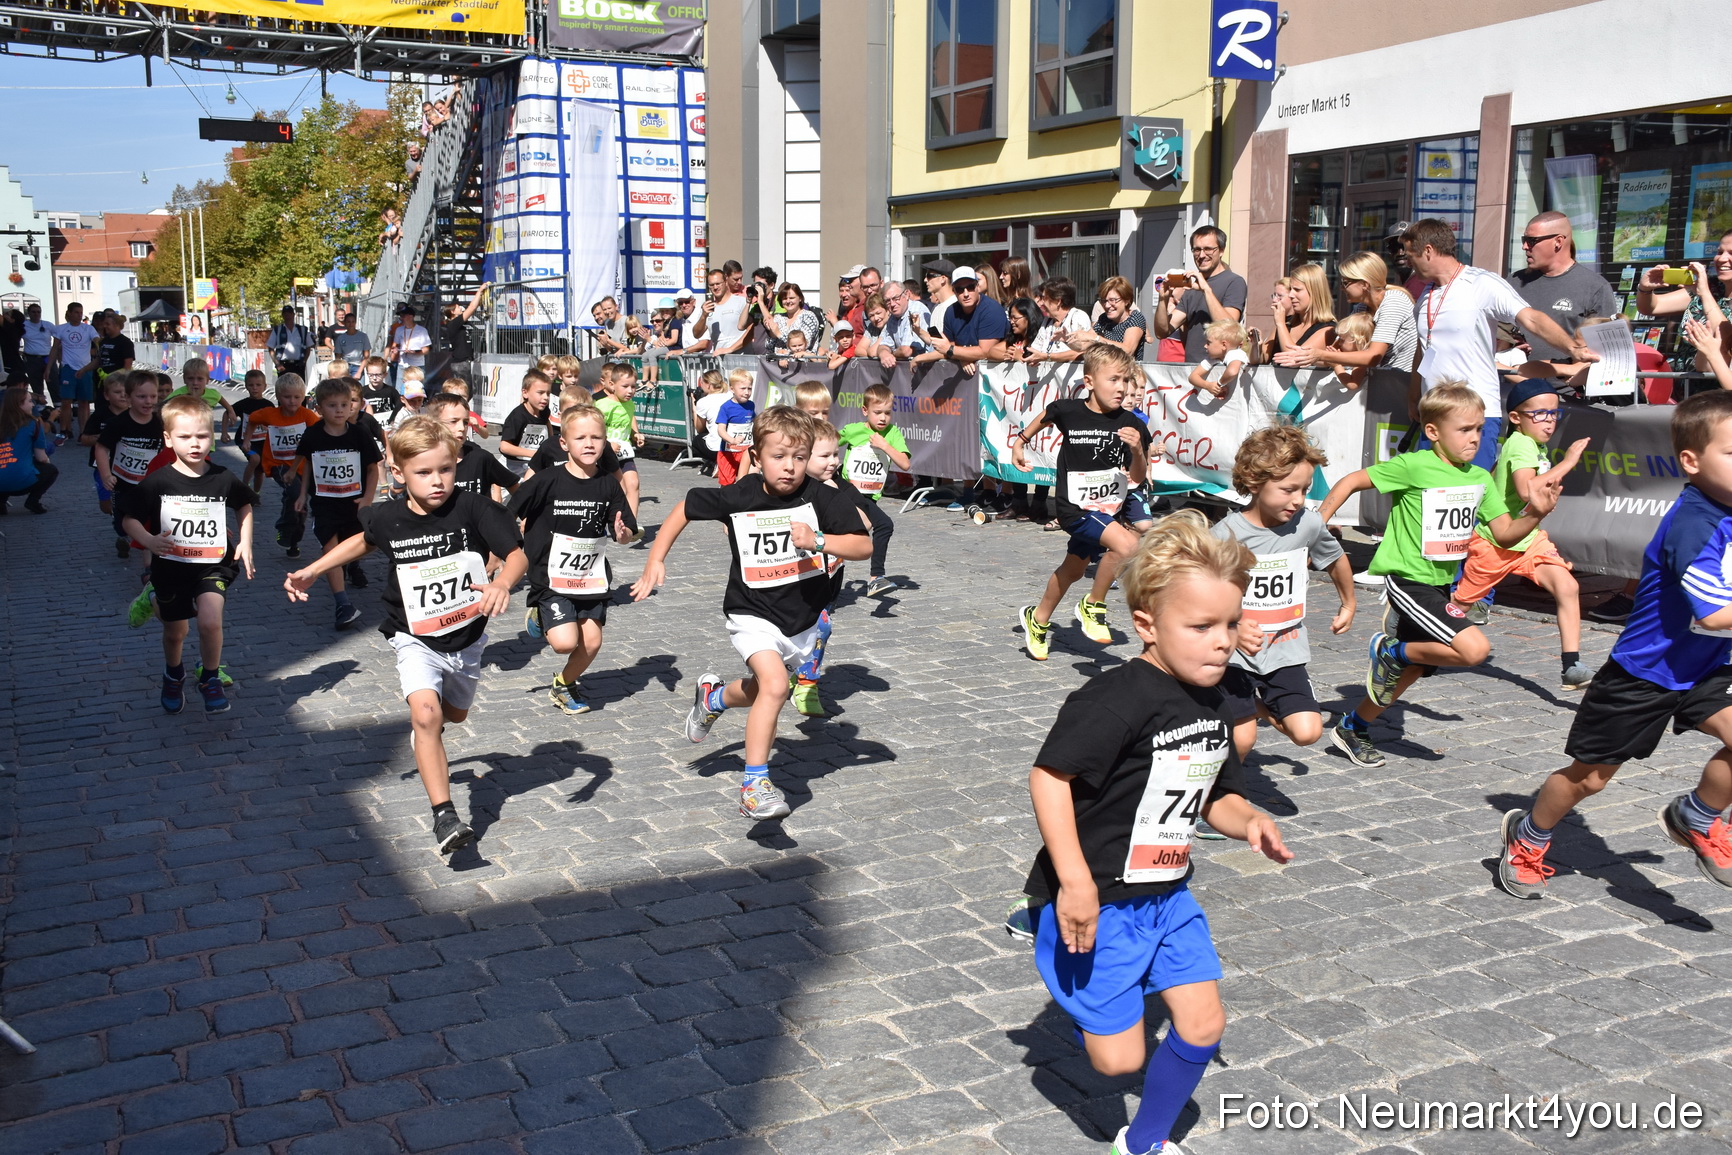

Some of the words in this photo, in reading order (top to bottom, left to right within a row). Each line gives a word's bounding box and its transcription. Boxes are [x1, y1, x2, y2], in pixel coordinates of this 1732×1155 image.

[453, 0, 500, 10] Stadtlauf
[559, 0, 660, 23] BOCK
[559, 19, 591, 29] inspired
[593, 21, 603, 31] by
[604, 24, 628, 32] smart
[630, 26, 665, 35] concepts
[1278, 101, 1309, 118] Unterer
[1312, 96, 1337, 113] Markt
[1340, 93, 1350, 107] 15
[280, 124, 290, 139] 4
[1622, 182, 1668, 193] Radfahren
[918, 397, 963, 415] LOUNGE
[524, 433, 544, 446] 7532
[1069, 429, 1109, 437] Neumarkter
[1070, 438, 1101, 446] Stadtlauf
[120, 453, 149, 471] 7375
[853, 460, 883, 476] 7092
[320, 464, 354, 479] 7435
[1078, 482, 1120, 501] 7502
[1446, 493, 1474, 502] BOCK
[552, 509, 588, 517] Stadtlauf
[171, 518, 218, 538] 7043
[757, 516, 791, 526] BOCK
[390, 534, 443, 549] Neumarkter
[183, 548, 203, 557] Elias
[393, 546, 433, 559] Stadtlauf
[559, 552, 599, 571] 7427
[420, 562, 459, 578] BOCK
[413, 572, 476, 608] 7374
[567, 580, 586, 588] Oliver
[443, 599, 468, 612] Neumarkt
[439, 611, 467, 627] Louis
[1152, 719, 1221, 748] Neumarkter
[1158, 831, 1184, 840] PARTL
